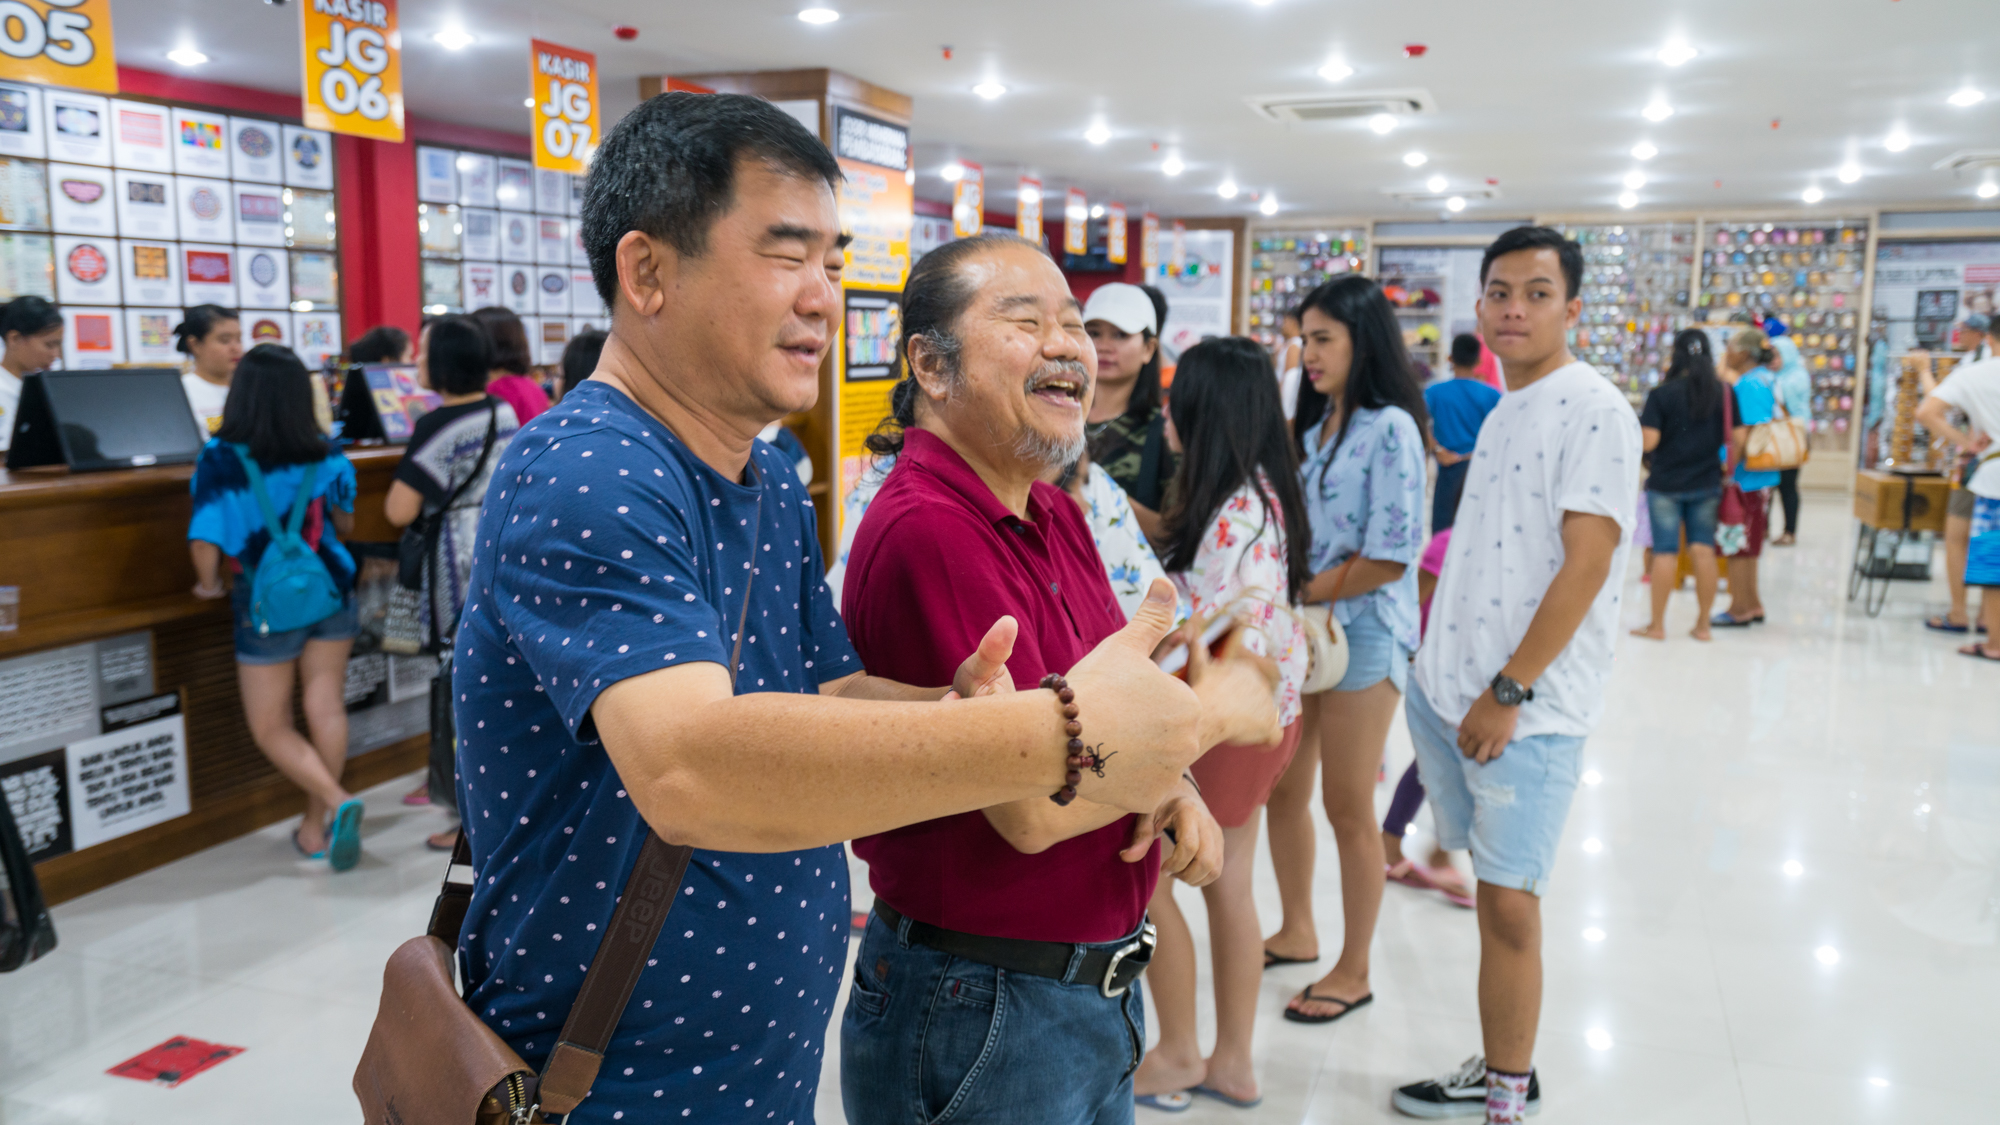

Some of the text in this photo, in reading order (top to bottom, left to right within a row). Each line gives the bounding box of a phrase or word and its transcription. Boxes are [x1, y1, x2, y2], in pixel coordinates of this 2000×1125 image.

[0, 0, 95, 66] 05
[317, 21, 389, 74] JG
[538, 51, 590, 83] KASIR
[321, 67, 390, 121] 06
[541, 80, 592, 122] JG
[543, 118, 592, 160] 07
[623, 855, 672, 945] Jeep
